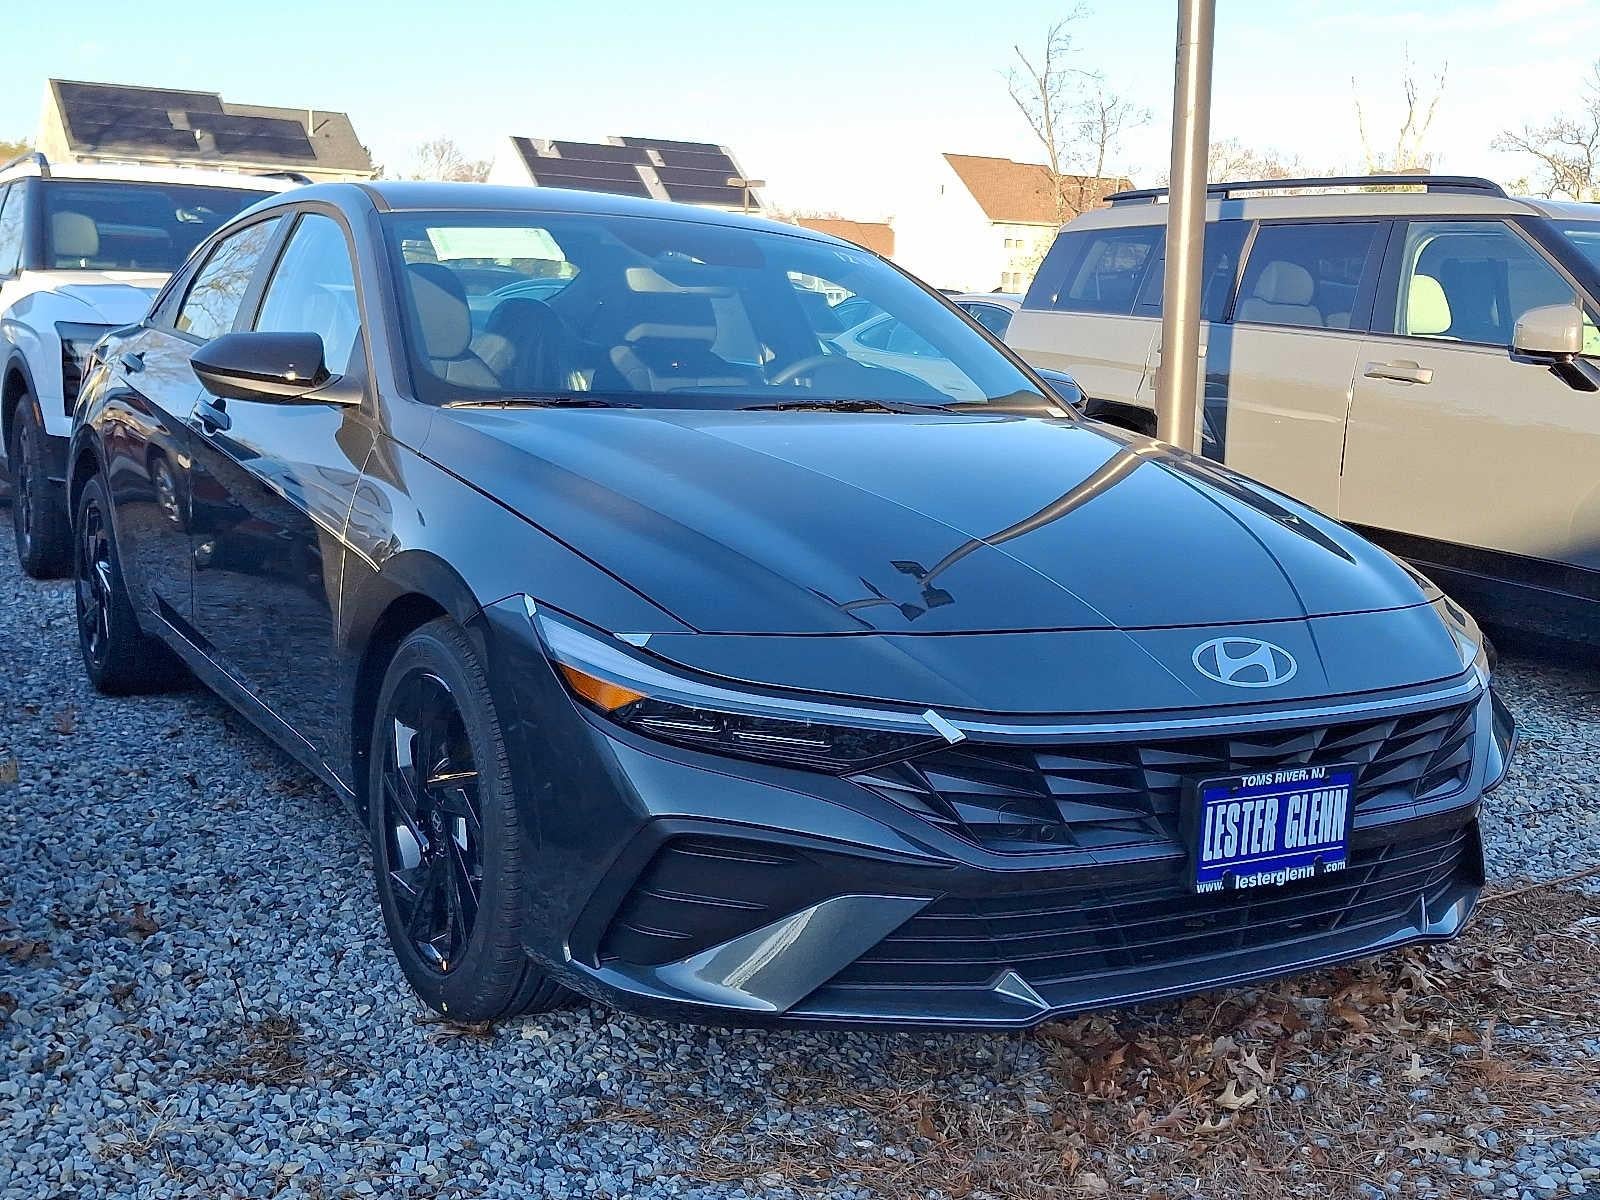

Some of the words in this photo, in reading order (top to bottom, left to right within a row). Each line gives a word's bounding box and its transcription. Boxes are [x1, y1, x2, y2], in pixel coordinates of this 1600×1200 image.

[1241, 774, 1273, 787] TOMS
[1311, 767, 1326, 779] NJ
[1202, 798, 1279, 862] LESTER
[1284, 788, 1349, 849] GLENN
